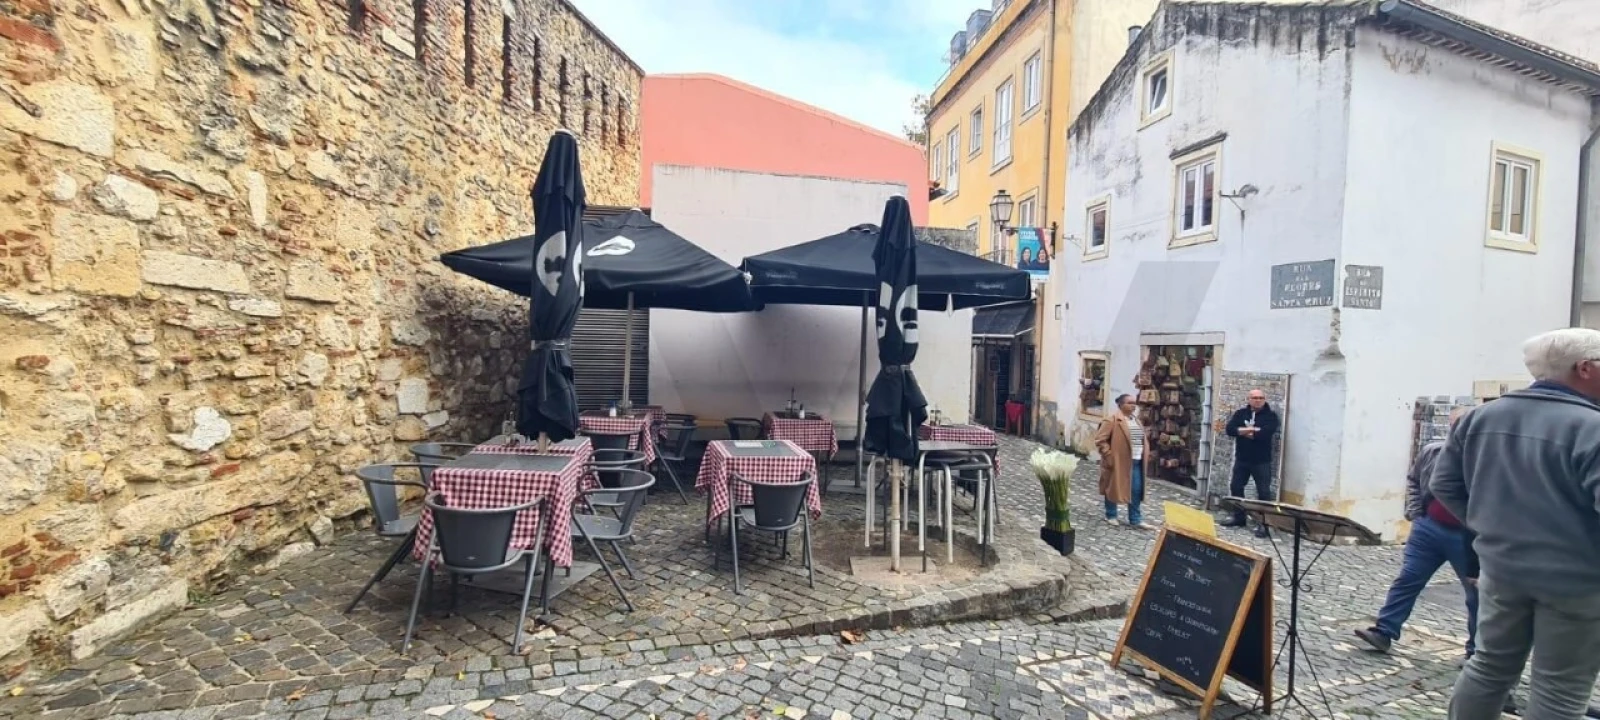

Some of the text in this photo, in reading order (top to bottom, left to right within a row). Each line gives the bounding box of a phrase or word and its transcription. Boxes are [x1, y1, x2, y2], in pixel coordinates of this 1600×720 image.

[1293, 264, 1312, 273] RUA
[1284, 281, 1321, 292] FLORES
[1271, 296, 1333, 307] SANTA CRUZ
